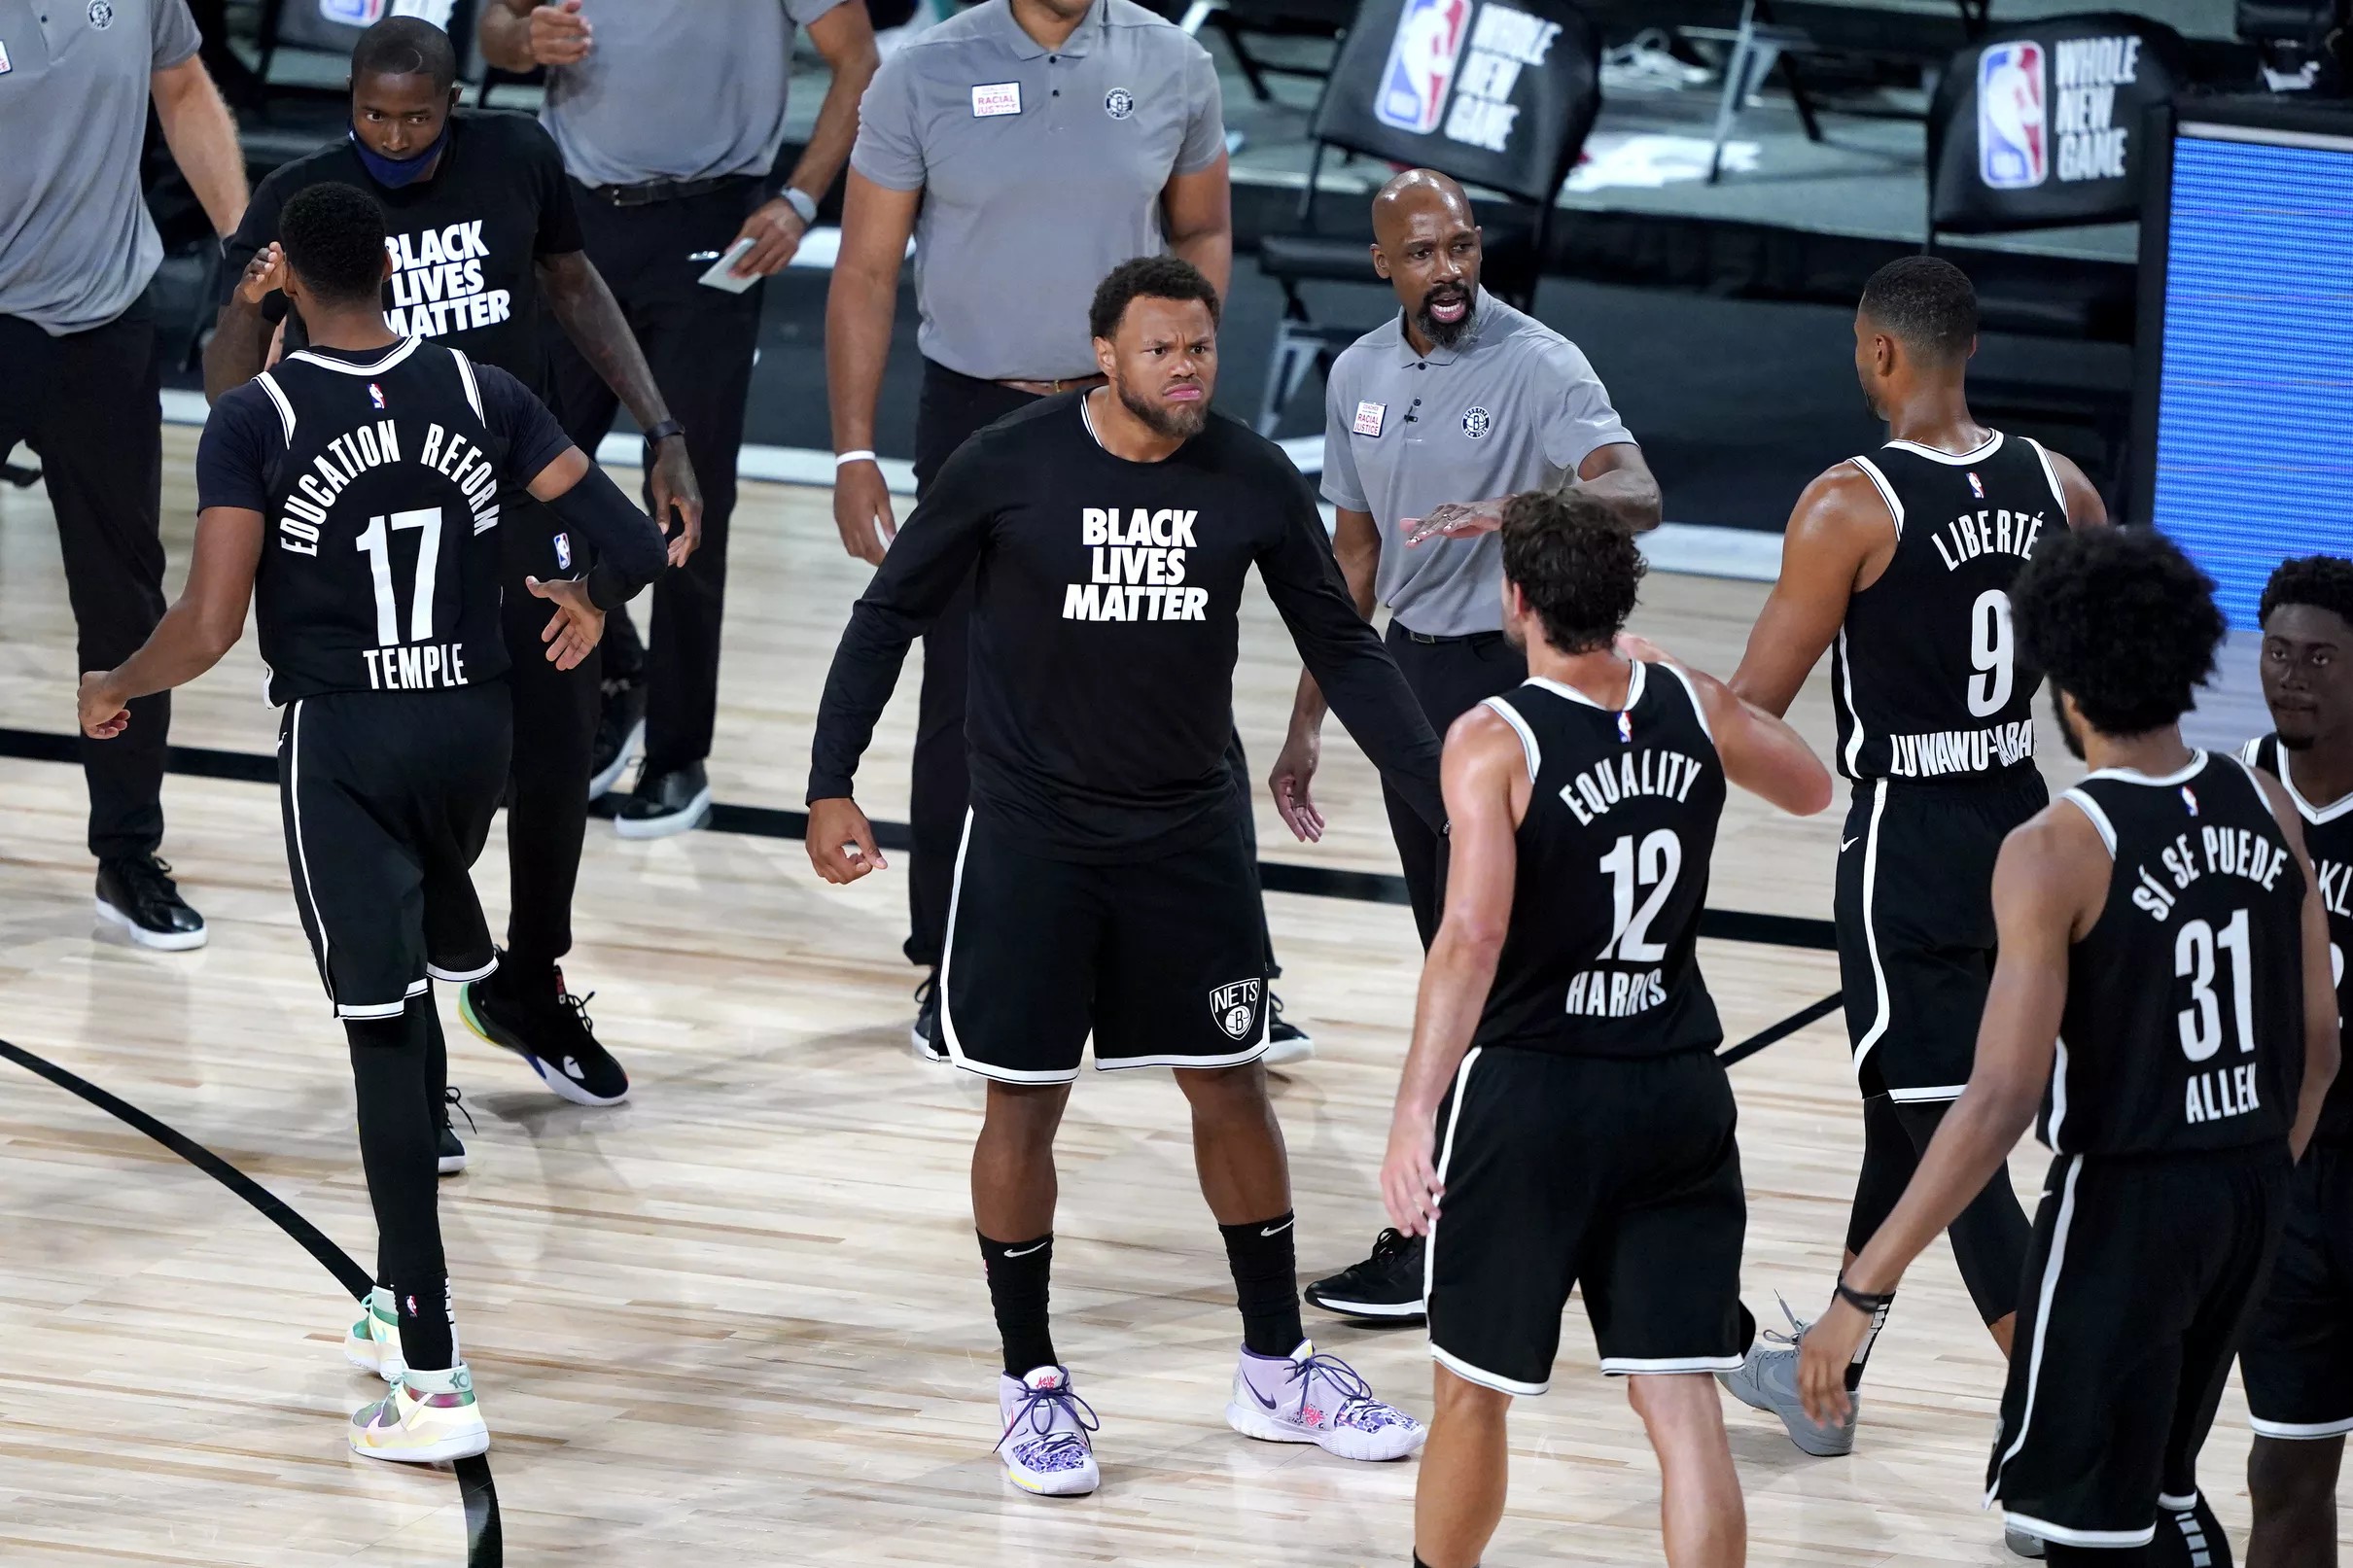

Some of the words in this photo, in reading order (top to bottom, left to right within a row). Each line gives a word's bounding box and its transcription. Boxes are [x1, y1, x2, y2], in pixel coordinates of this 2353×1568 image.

[2054, 35, 2142, 87] WHOLE
[977, 94, 1015, 105] RACIAL
[2054, 85, 2116, 135] NEW
[2056, 127, 2128, 182] GAME
[391, 259, 485, 307] LIVES
[1353, 423, 1379, 435] JUSTICE
[1357, 413, 1379, 425] RACIAL
[280, 418, 402, 558] EDUCATION
[419, 423, 501, 537] REFORM
[1082, 507, 1199, 548] BLACK
[1930, 508, 2045, 572] LIBERTÉ
[355, 506, 442, 647] 17
[1091, 546, 1186, 586] LIVES
[1062, 583, 1210, 622] MATTER
[363, 643, 469, 690] TEMPLE
[1967, 589, 2015, 717] 9
[1559, 748, 1703, 826] EQUALITY
[1595, 828, 1682, 962] 12
[2131, 863, 2177, 923] SÍ
[2161, 832, 2200, 889] SE
[2201, 824, 2288, 893] PUEDE
[1213, 980, 1258, 1014] NETS
[1565, 967, 1668, 1018] HARRIS
[2174, 908, 2256, 1063] 31
[2185, 1061, 2261, 1125] ALLEN
